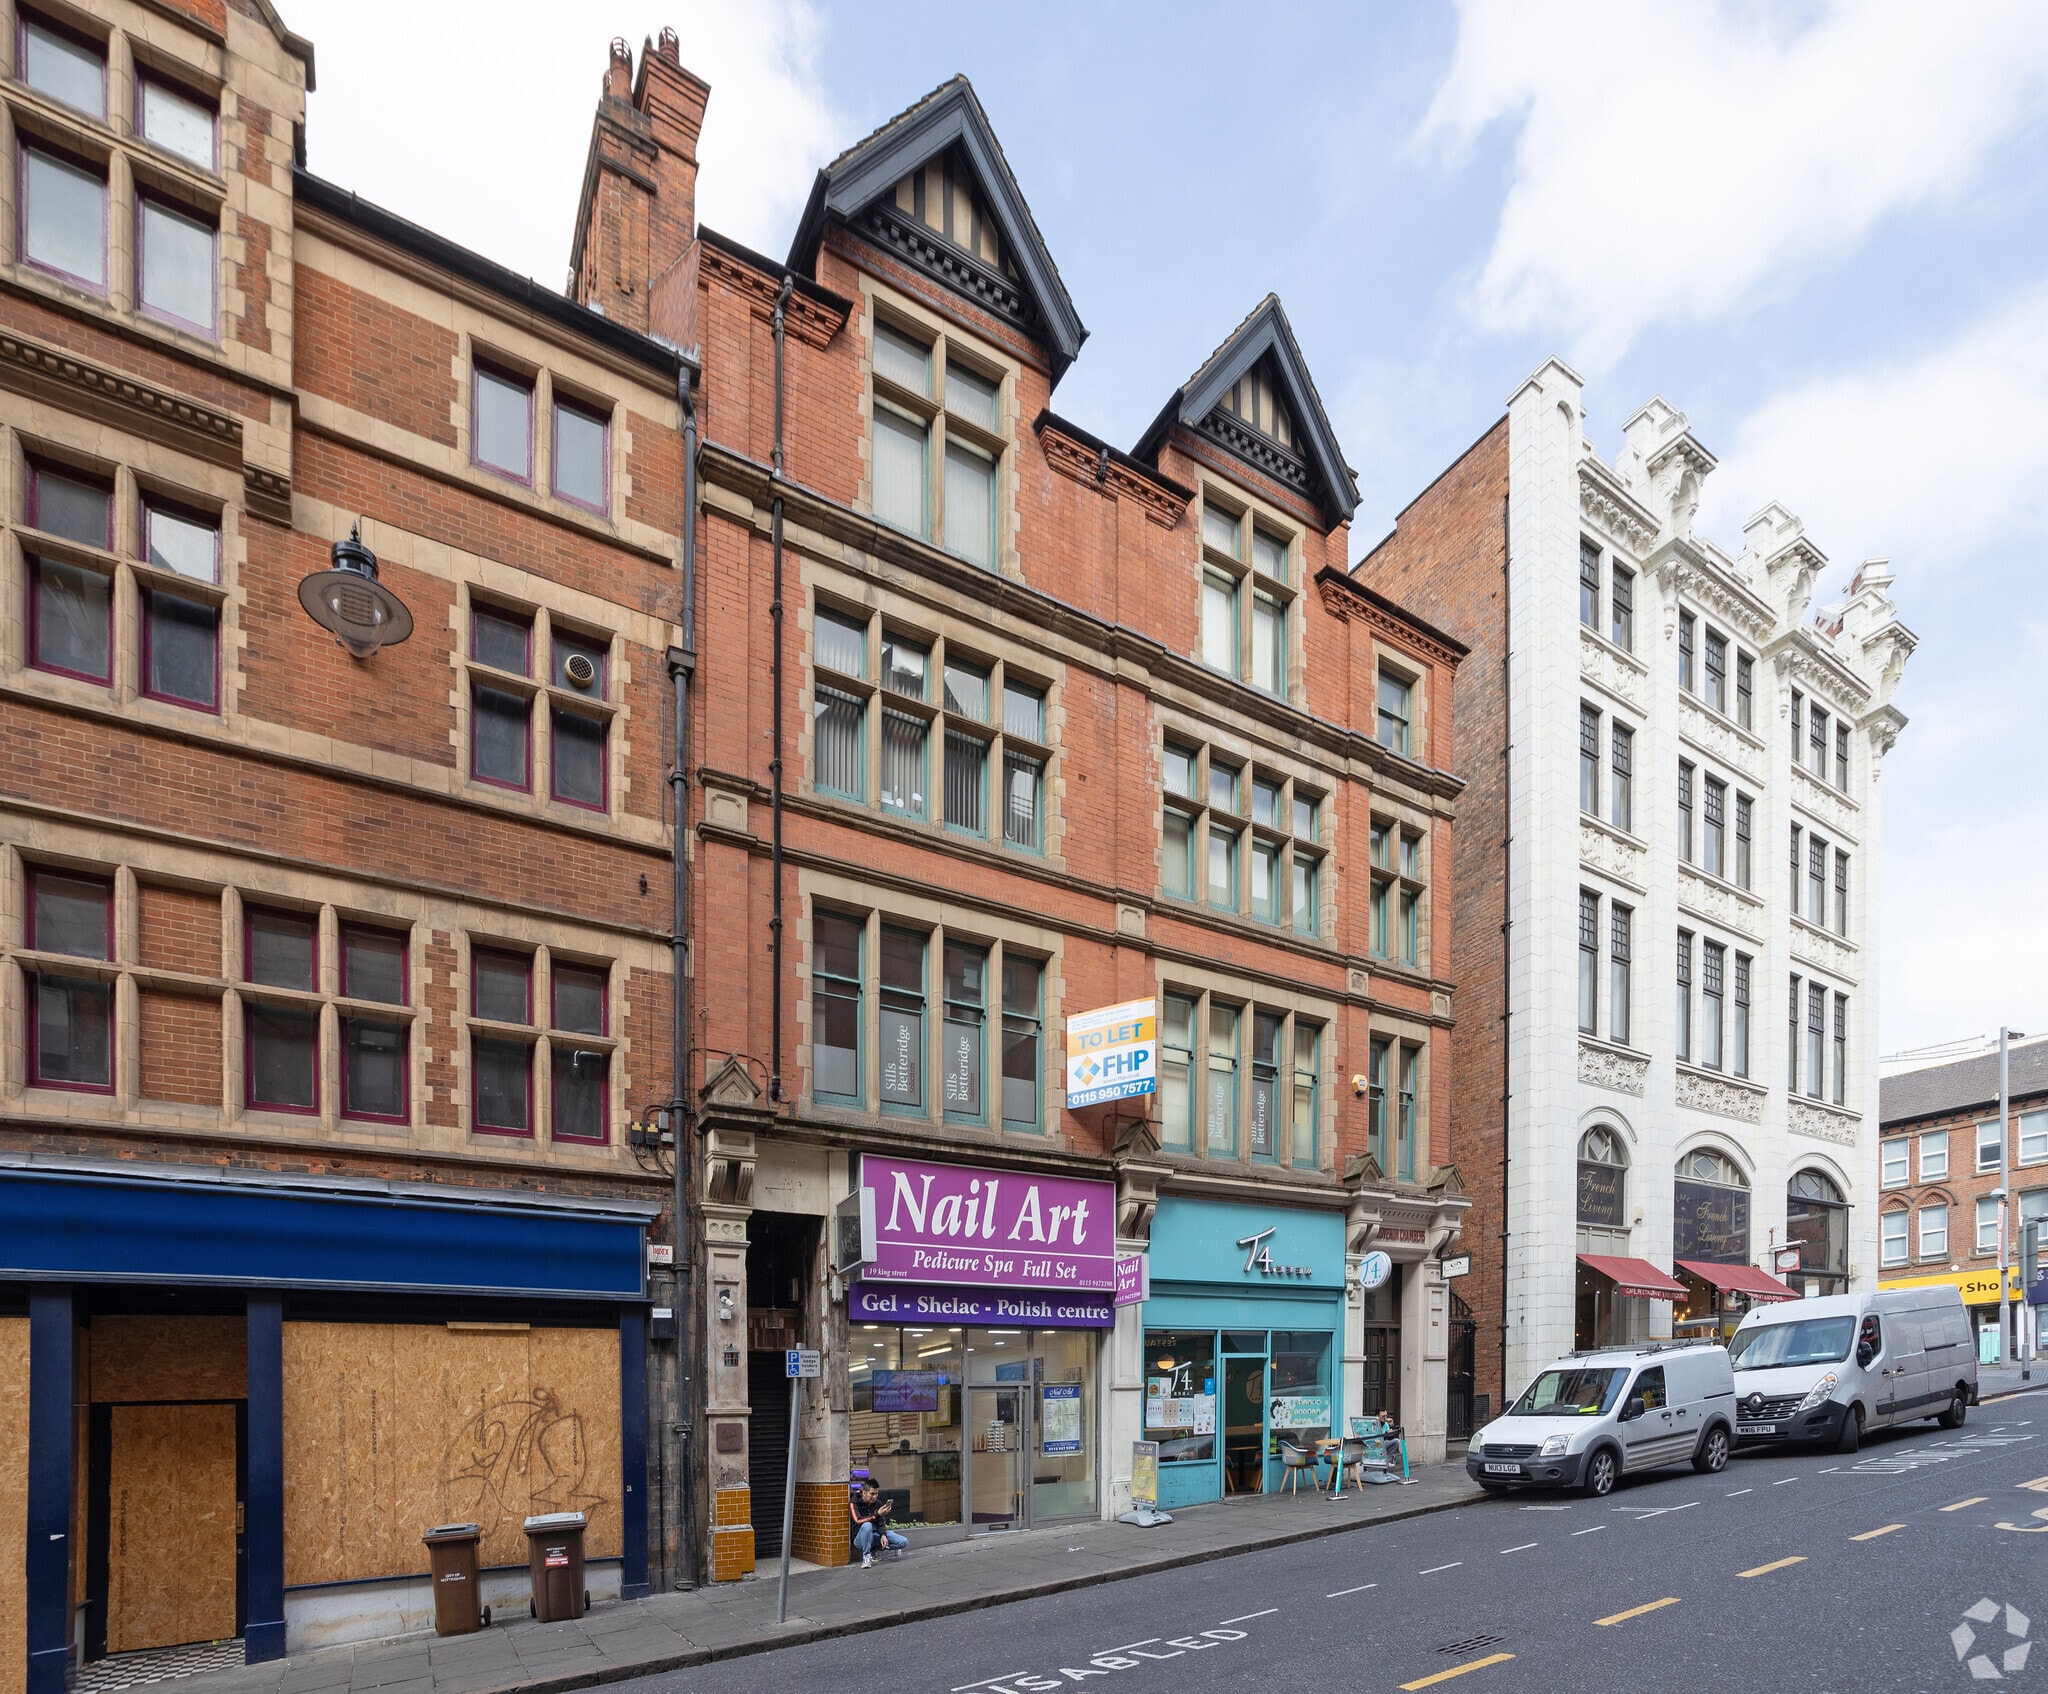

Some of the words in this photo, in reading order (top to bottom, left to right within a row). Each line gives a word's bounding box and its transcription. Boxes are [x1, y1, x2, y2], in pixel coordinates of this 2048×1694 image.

[1078, 1032, 1102, 1049] TO
[1108, 1022, 1143, 1043] LET
[897, 1025, 911, 1092] Betteridge
[958, 1036, 971, 1101] Betteridge
[1103, 1049, 1149, 1077] FHP
[885, 1062, 896, 1091] Sills
[947, 1073, 957, 1100] Sills
[1072, 1091, 1096, 1105] 0115
[1099, 1086, 1120, 1099] 950
[1122, 1080, 1150, 1094] 7577
[1215, 1083, 1224, 1138] Betteridge
[1257, 1090, 1267, 1145] Betteridge
[1578, 1171, 1616, 1194] French
[884, 1171, 999, 1239] Nail
[1007, 1185, 1090, 1246] Art
[1579, 1191, 1613, 1223] Living
[1697, 1202, 1729, 1222] French
[1697, 1222, 1727, 1251] Living
[652, 1247, 669, 1255] INDEX
[912, 1250, 979, 1271] Pedicure
[984, 1254, 1014, 1278] Spa
[1022, 1259, 1051, 1278] Full
[1055, 1261, 1077, 1279] Set
[878, 1268, 891, 1277] king
[1116, 1259, 1139, 1276] Nail
[1118, 1277, 1136, 1291] Art
[862, 1293, 897, 1312] Gel
[917, 1295, 979, 1315] Shelac
[997, 1299, 1052, 1318] Polish
[1057, 1305, 1109, 1320] centre
[962, 1629, 1248, 1694] ISABLED
